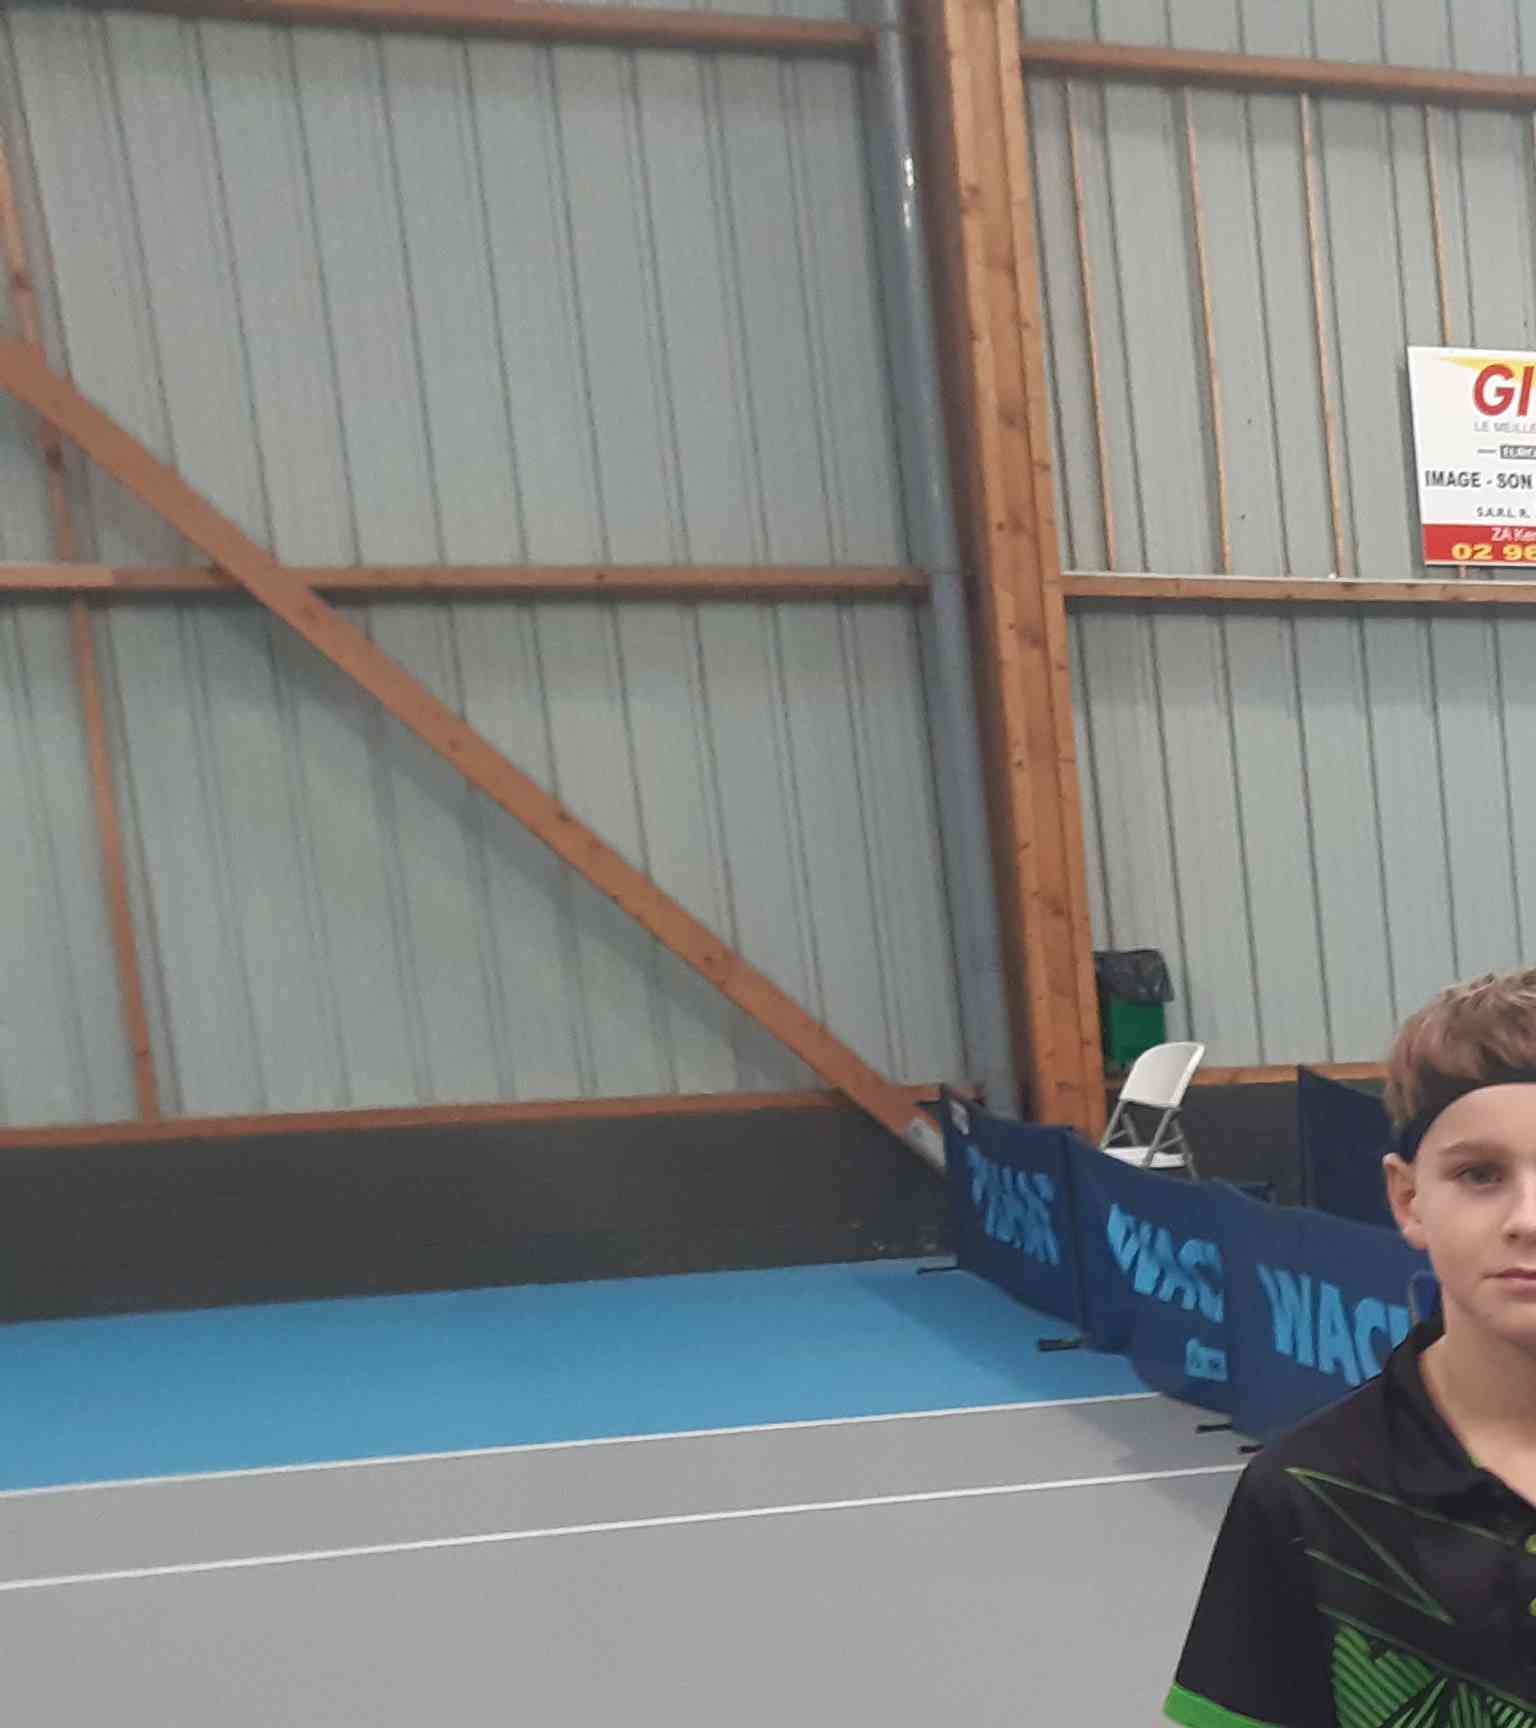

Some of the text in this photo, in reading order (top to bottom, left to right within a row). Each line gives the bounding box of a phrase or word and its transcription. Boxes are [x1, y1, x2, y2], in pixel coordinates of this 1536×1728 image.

[1425, 470, 1482, 488] IMAGE
[1496, 473, 1532, 490] SON
[1491, 527, 1511, 542] ZA
[1451, 542, 1494, 561] 02
